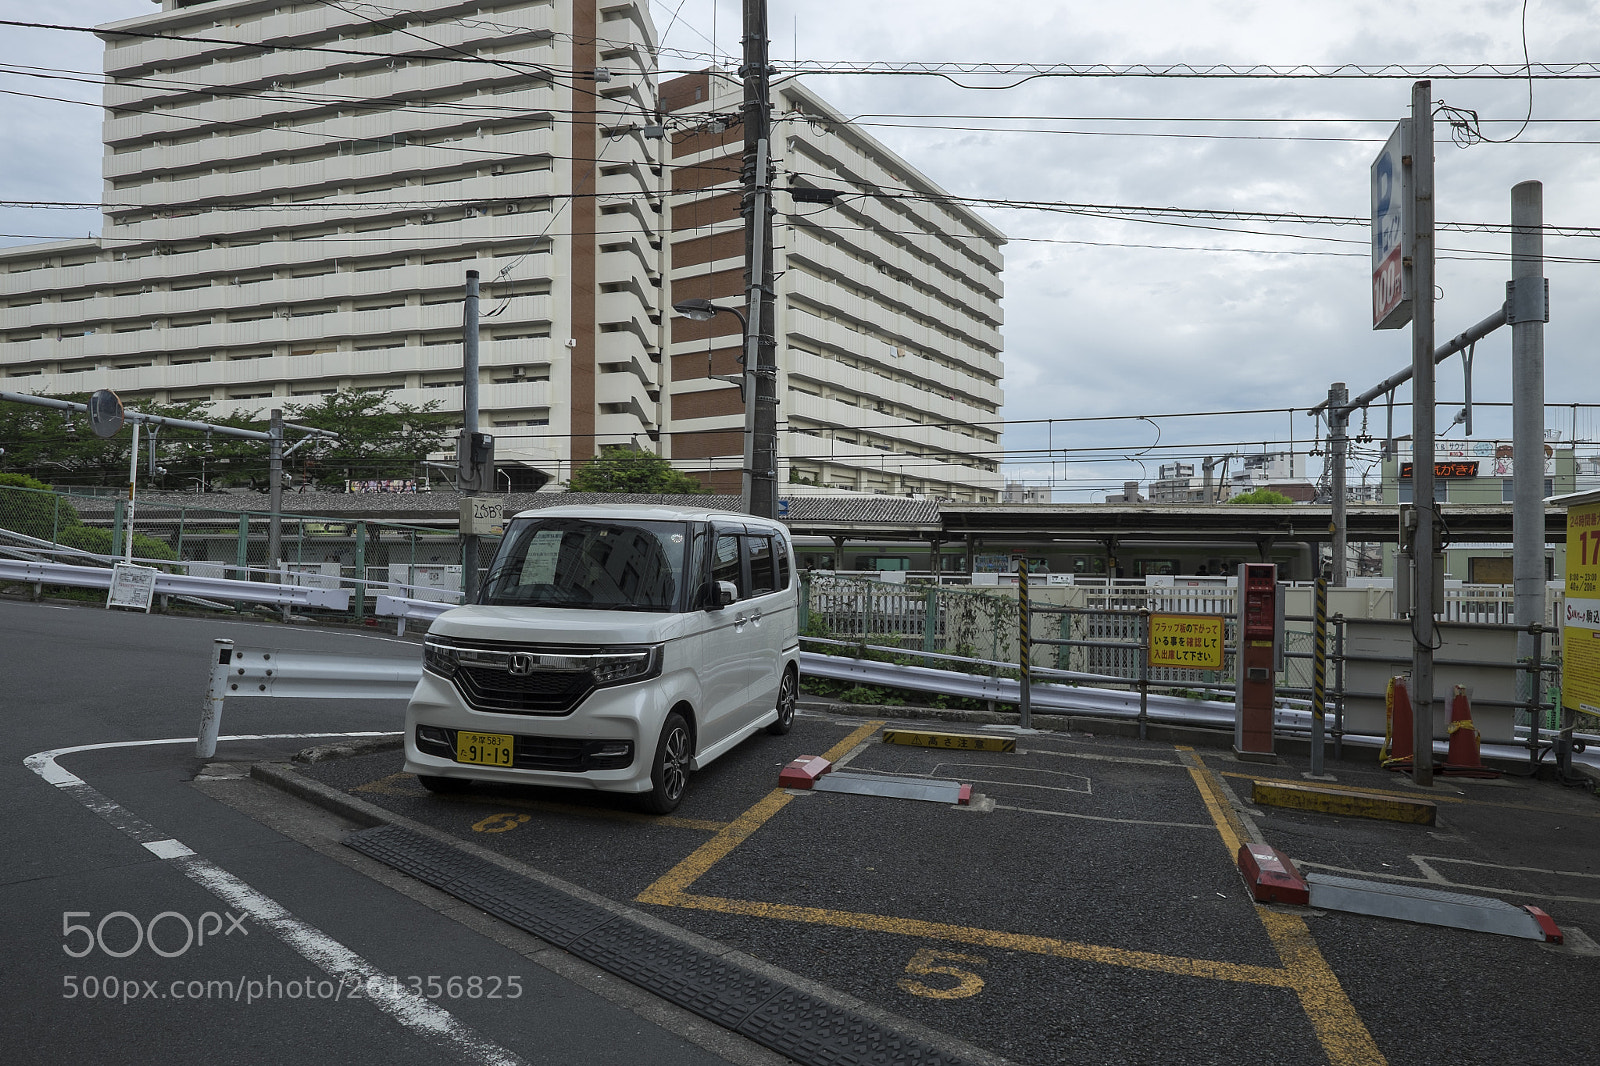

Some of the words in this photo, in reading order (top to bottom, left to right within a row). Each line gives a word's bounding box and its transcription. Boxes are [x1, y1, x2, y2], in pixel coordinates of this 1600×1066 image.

[1376, 151, 1392, 264] P
[1383, 215, 1400, 252] コイン
[1374, 261, 1400, 317] 100円
[1154, 622, 1218, 635] フラップ板の下がって
[1154, 636, 1217, 649] いる事を確認して
[1153, 649, 1214, 663] 入出庫して下さい。
[471, 735, 486, 745] 多摩
[487, 736, 501, 746] 583
[928, 736, 985, 749] 高さ注意
[469, 745, 510, 764] 91-19
[471, 813, 531, 833] 6
[896, 948, 988, 1000] 5
